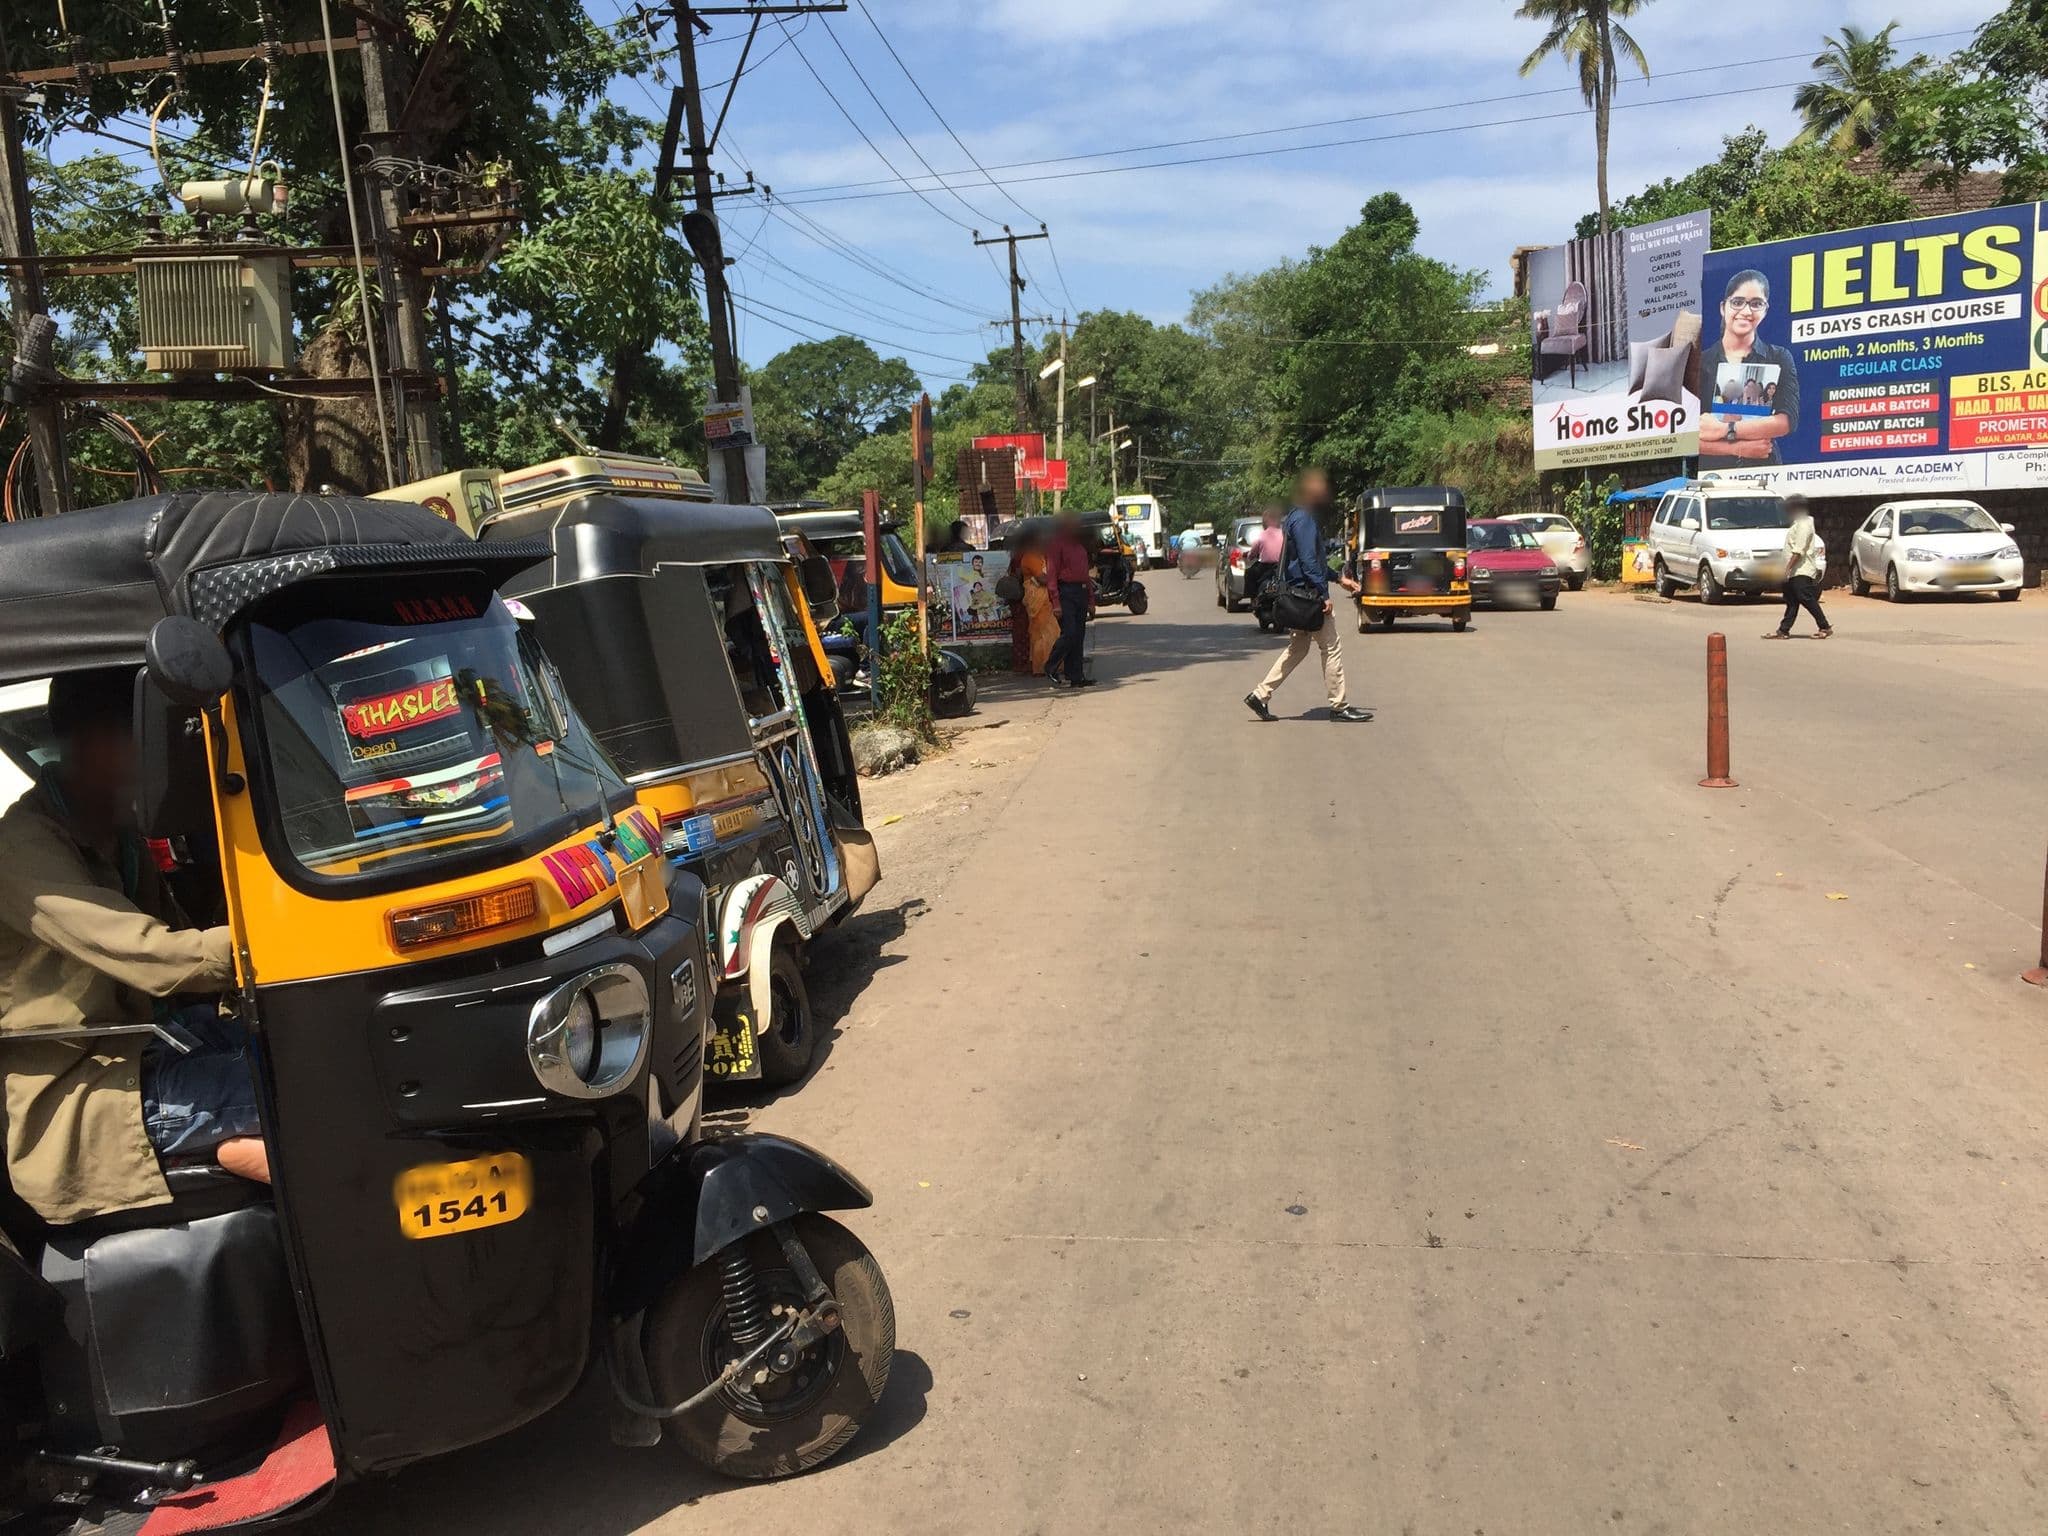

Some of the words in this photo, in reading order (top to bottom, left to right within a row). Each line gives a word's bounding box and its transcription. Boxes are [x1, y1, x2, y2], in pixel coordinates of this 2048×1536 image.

[1630, 244, 1646, 253] WILL
[1647, 240, 1661, 249] WIN
[1662, 235, 1680, 246] YOUR
[1680, 229, 1703, 241] PRAISE
[1645, 225, 1674, 240] TASTEFUL
[1649, 249, 1682, 263] CURTAINS
[1651, 260, 1681, 273] CARPETS
[1790, 225, 2022, 313] IELTS
[1648, 270, 1685, 284] FLOORINGS
[1654, 282, 1678, 293] BLINDS
[1644, 296, 1661, 305] WALL
[1662, 290, 1688, 301] PAPERS
[1675, 299, 1696, 309] LINEN
[1796, 322, 1815, 338] 15
[1820, 316, 1862, 335] DAYS
[1867, 310, 1926, 330] CRASH
[1931, 300, 2006, 322] COURSE
[1856, 343, 1865, 356] 2
[1867, 337, 1919, 356] Months,
[1922, 336, 1931, 350] 3
[1934, 331, 1985, 349] Months
[1839, 359, 1897, 378] REGULAR
[1900, 355, 1943, 373] CLASS
[1829, 385, 1887, 401] MORNING
[1889, 381, 1931, 397] BATCH
[1978, 375, 2016, 393] BLS,
[1829, 402, 1886, 417] REGULAR
[1889, 398, 1930, 413] BATCH
[2027, 393, 2048, 411] UA
[1557, 415, 1619, 440] Home
[1627, 405, 1686, 434] Shop
[1832, 419, 1882, 434] SUNDAY
[1884, 416, 1925, 431] BATCH
[1556, 449, 1571, 457] HOTEL
[1625, 441, 1641, 449] BUNTS
[1642, 439, 1661, 447] HOSTEL
[1829, 435, 1884, 449] EVENING
[1886, 432, 1928, 446] BATCH
[1562, 455, 1591, 464] MANGALURU
[2016, 450, 2048, 460] Compl
[1787, 466, 1887, 481] INTERNATIONAL
[1895, 461, 1964, 475] ACADEMY
[2025, 462, 2047, 472] Ph:
[610, 478, 637, 488] SLEEP
[656, 481, 663, 489] A
[1877, 476, 1904, 485] Trusted
[1906, 475, 1928, 483] hands
[358, 678, 486, 728] THASLEE
[413, 1190, 508, 1227] 1541
